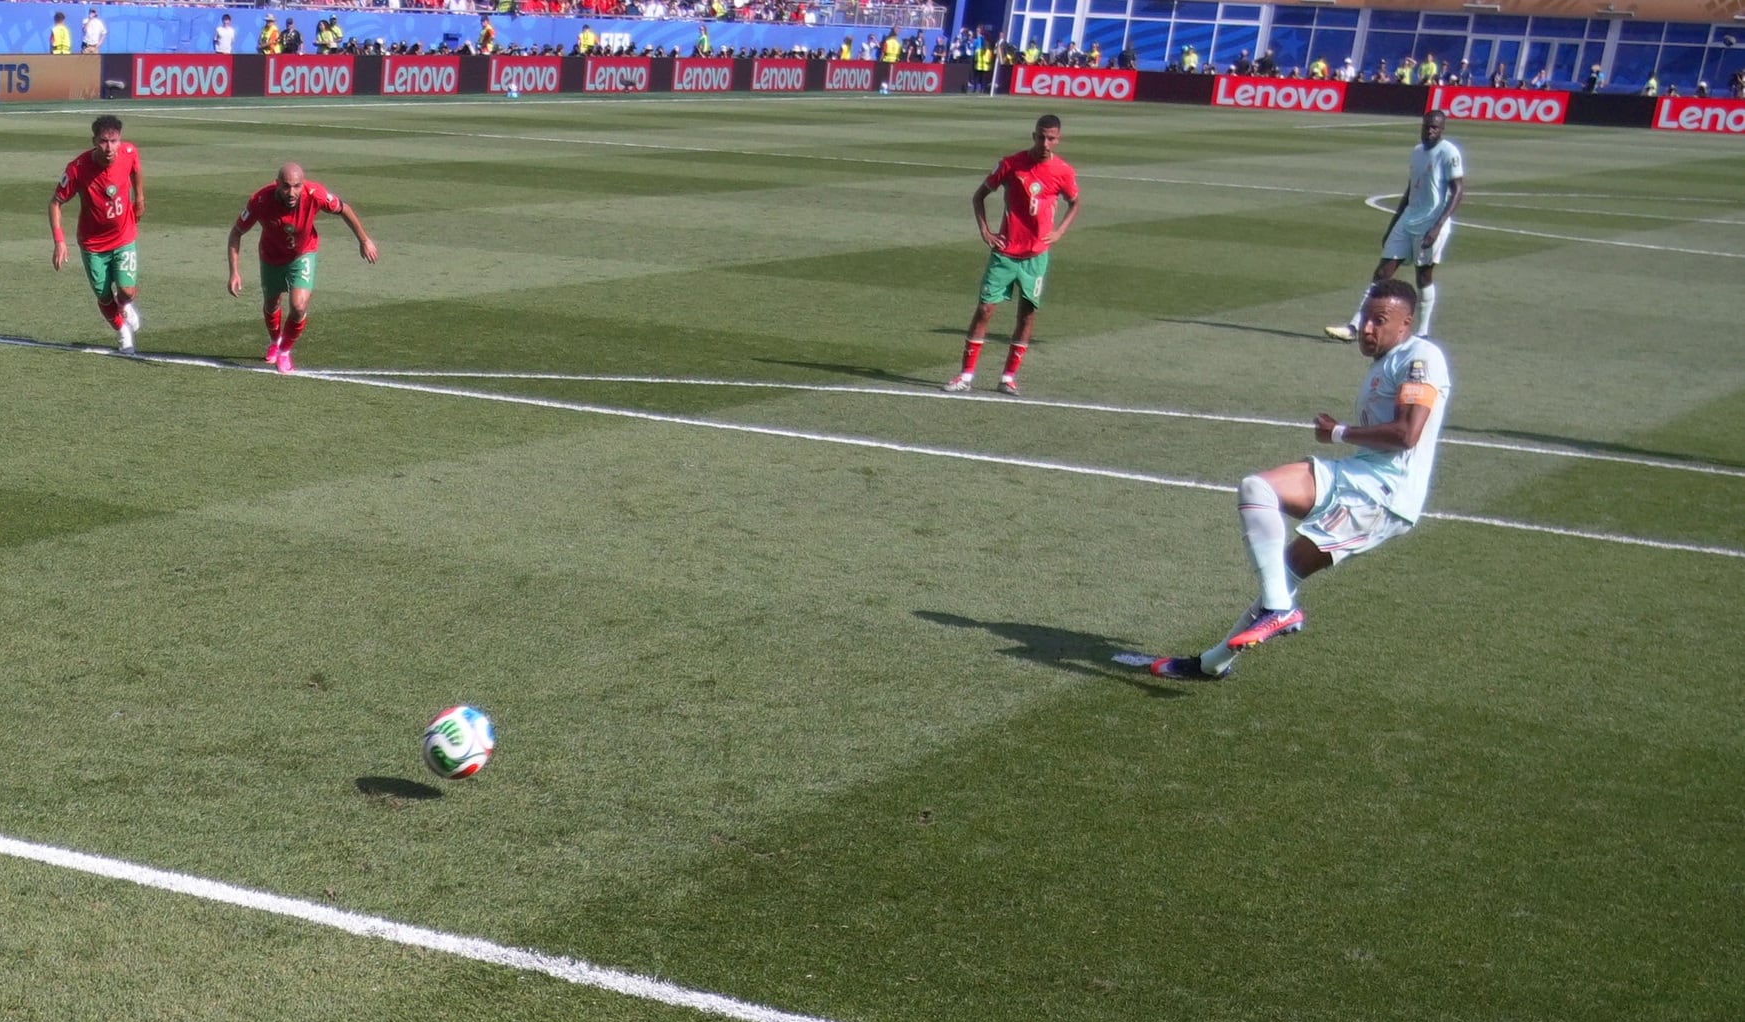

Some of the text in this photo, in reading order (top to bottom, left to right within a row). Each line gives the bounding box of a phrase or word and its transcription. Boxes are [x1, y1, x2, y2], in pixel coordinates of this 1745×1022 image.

[136, 58, 228, 95] Lenovo
[268, 58, 350, 94] Lenovo
[383, 59, 455, 93] Lenovo
[490, 59, 557, 91] Lenovo
[673, 60, 730, 90] Lenovo
[752, 61, 803, 89] Lenovo
[825, 61, 871, 89] Lenovo
[888, 63, 938, 91] Lenovo
[1015, 67, 1129, 98] Lenovo
[1216, 77, 1338, 110] Lenovo
[1430, 88, 1560, 122] Lenovo
[105, 197, 123, 219] 26
[1029, 197, 1039, 216] 8
[287, 235, 296, 250] 3
[120, 251, 137, 272] 26
[301, 257, 311, 276] 3
[1033, 277, 1043, 297] 8
